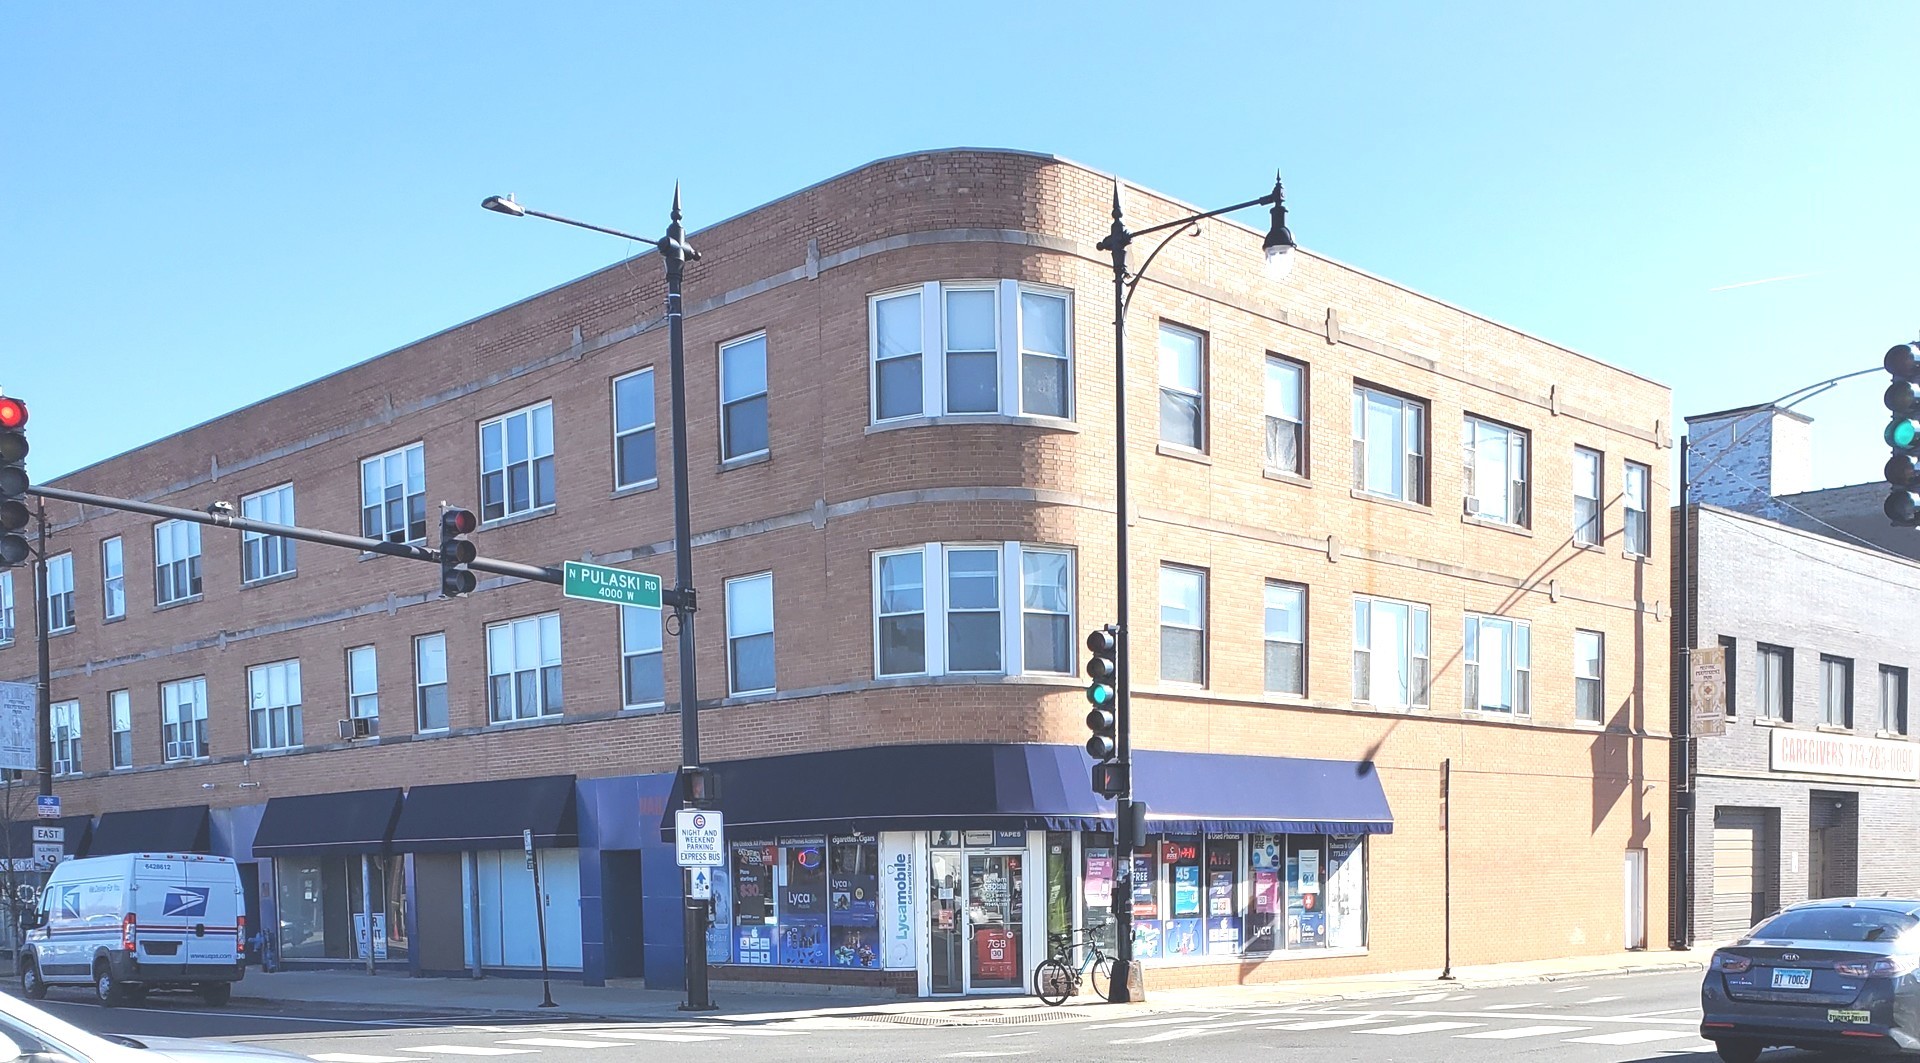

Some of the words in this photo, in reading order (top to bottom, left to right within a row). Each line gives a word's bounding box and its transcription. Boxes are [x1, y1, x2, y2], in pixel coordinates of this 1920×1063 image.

[569, 568, 576, 579] N
[581, 568, 640, 591] PULASKI
[644, 580, 657, 591] RD
[598, 587, 623, 599] 4000
[626, 591, 634, 601] W
[1782, 736, 1844, 767] CAREGIVERS
[38, 829, 60, 839] EAST
[685, 836, 715, 844] WEEKEND
[686, 843, 714, 851] PARKING
[680, 852, 707, 861] EXPRESS
[708, 853, 720, 861] BUS
[832, 879, 848, 889] Lyca
[788, 891, 811, 906] Lyca
[895, 853, 910, 940] Lycamobile
[986, 939, 1007, 949] 7GB
[1774, 974, 1783, 984] BT
[1788, 974, 1809, 985] 70026
[1851, 1014, 1869, 1022] DRIVER
